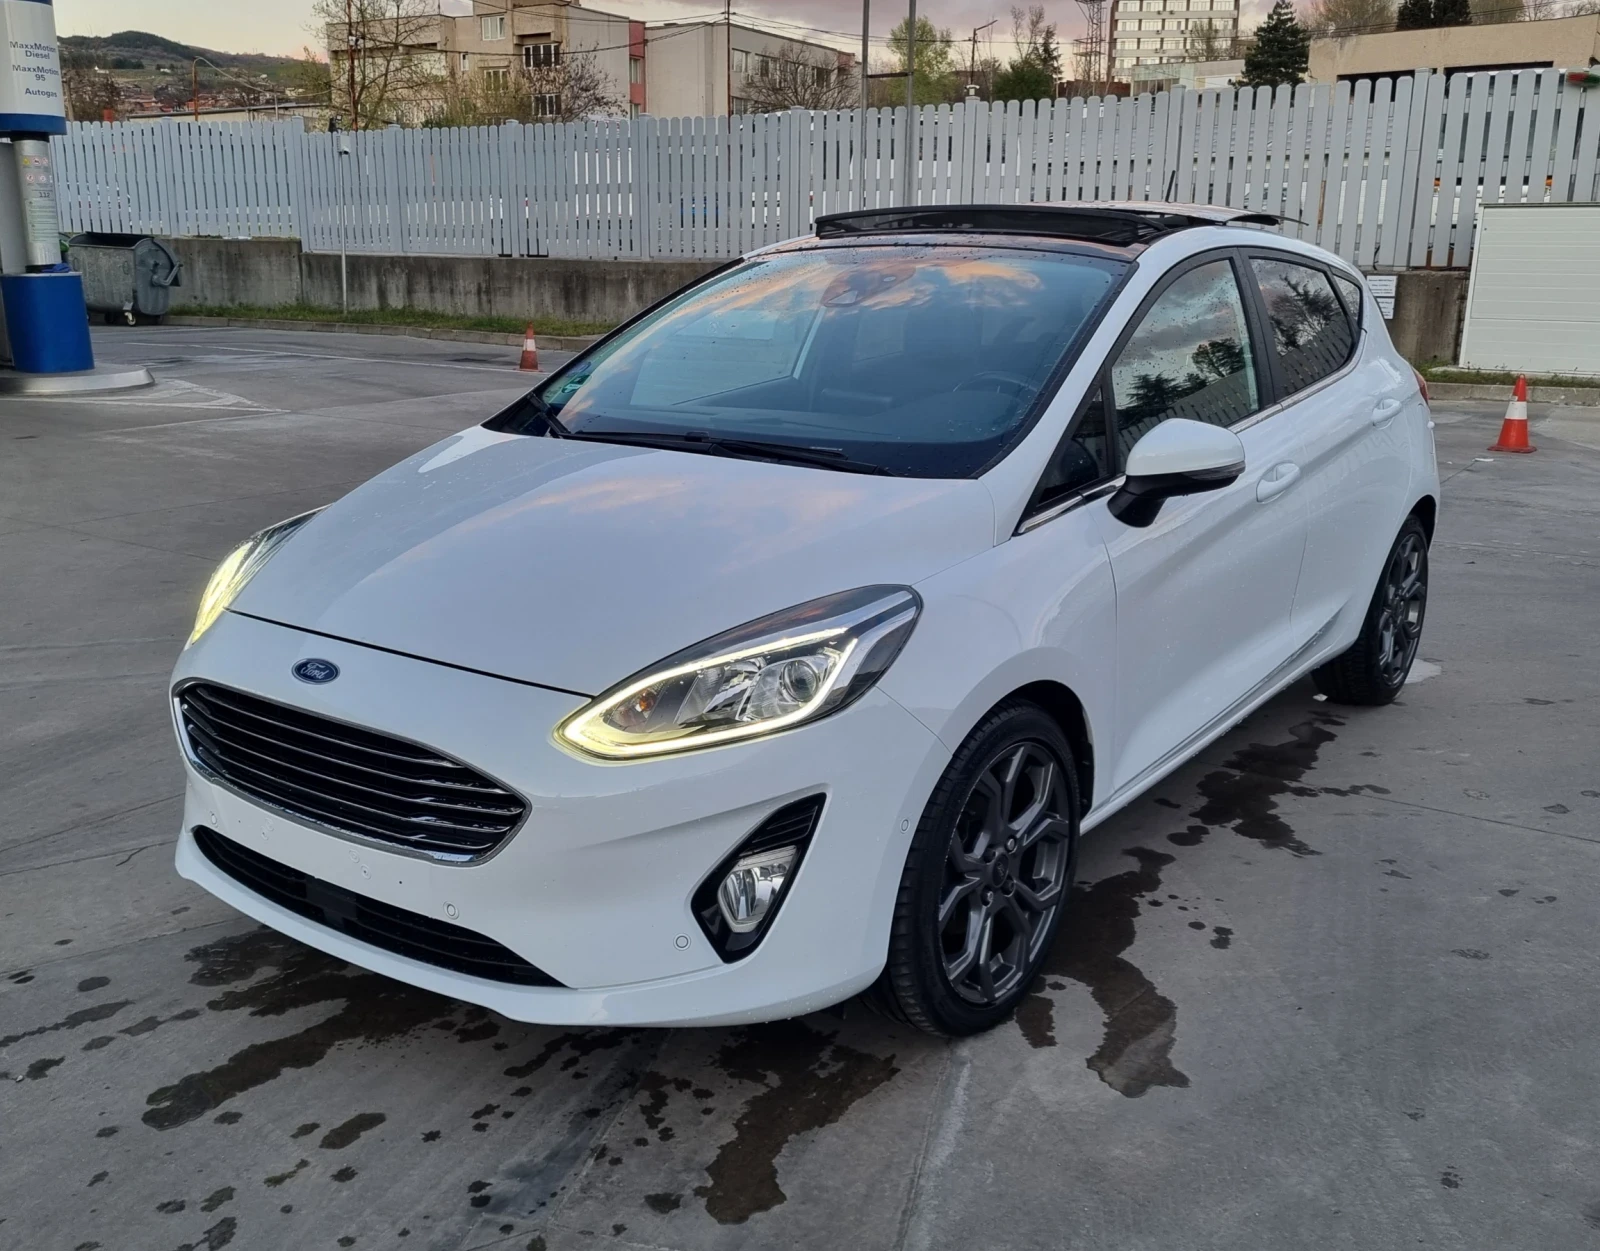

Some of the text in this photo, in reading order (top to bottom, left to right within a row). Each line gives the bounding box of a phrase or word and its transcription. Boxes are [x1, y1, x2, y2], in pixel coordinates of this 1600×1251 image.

[10, 41, 56, 53] MaxxMotion
[25, 50, 50, 59] Diesel
[12, 64, 59, 75] MaxxMotion
[25, 88, 57, 98] Autogas
[300, 662, 330, 679] Ford
